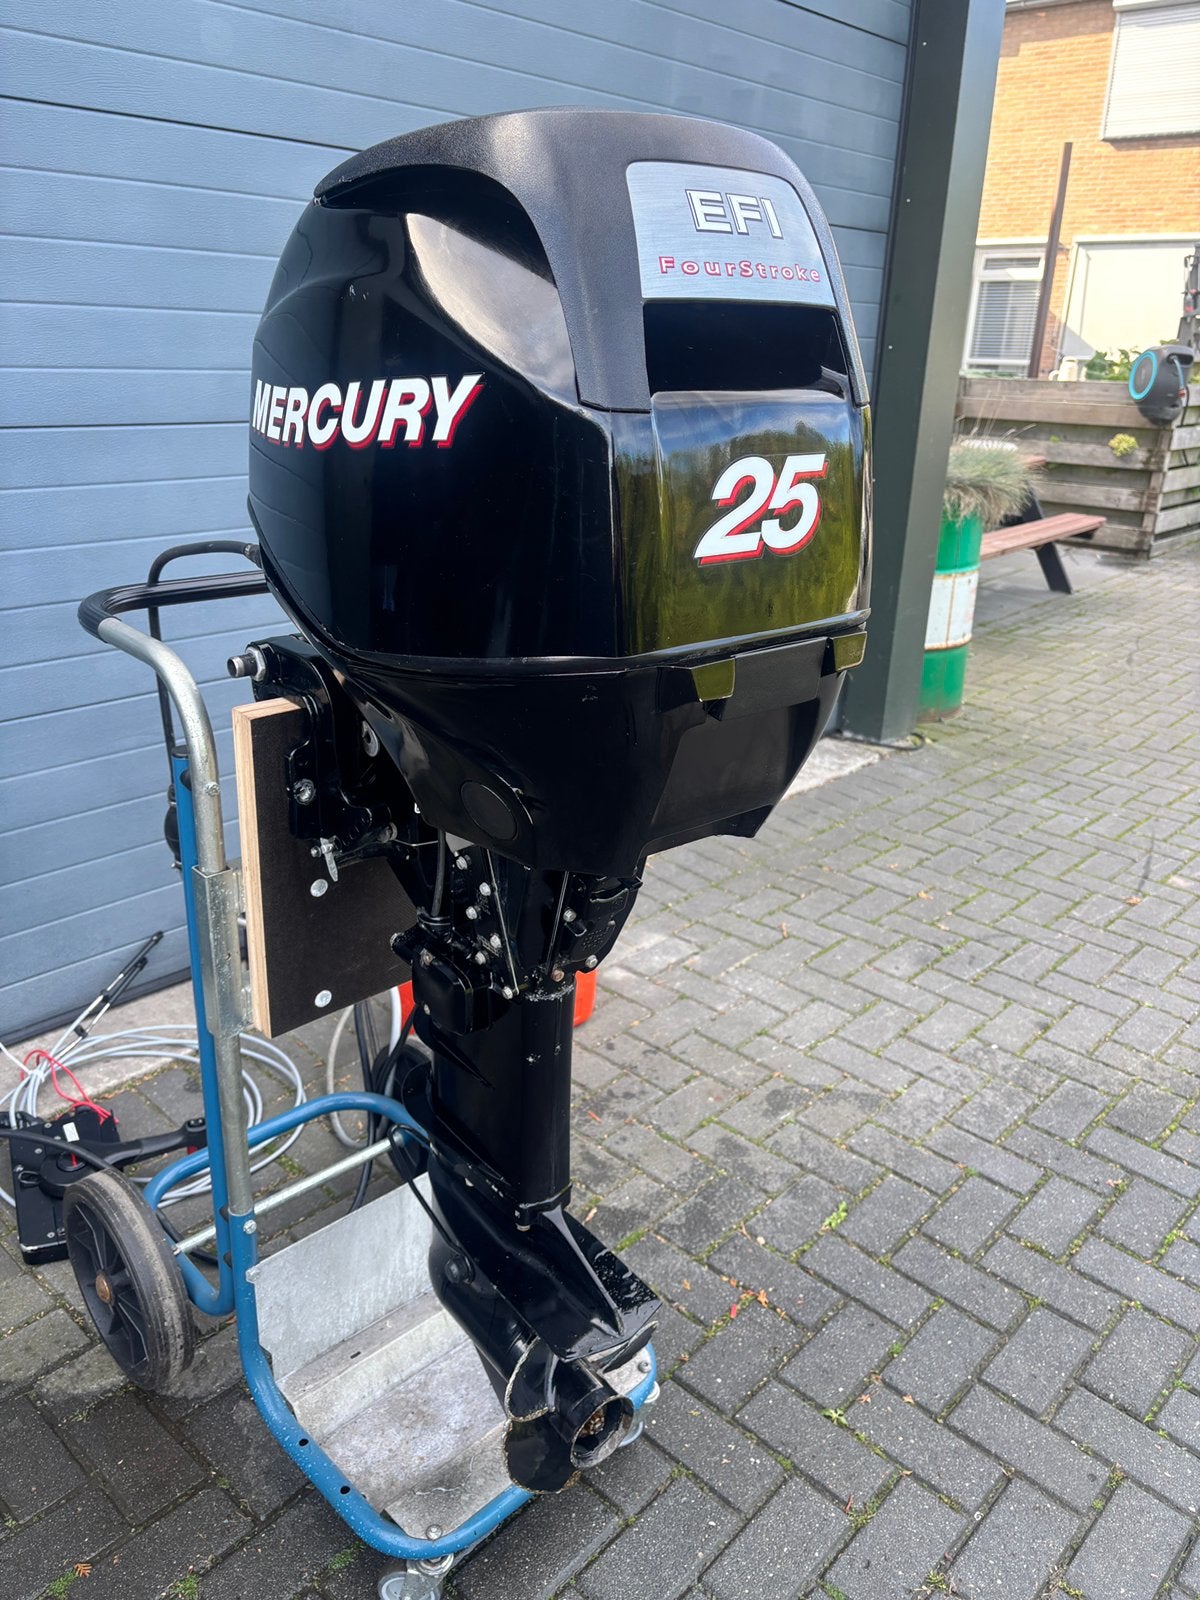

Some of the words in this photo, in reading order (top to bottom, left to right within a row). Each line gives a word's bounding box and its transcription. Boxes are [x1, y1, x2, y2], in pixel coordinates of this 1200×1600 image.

[684, 188, 784, 240] EFI
[658, 256, 821, 283] FourStroke
[252, 373, 485, 450] MERCURY
[694, 453, 828, 565] 25
